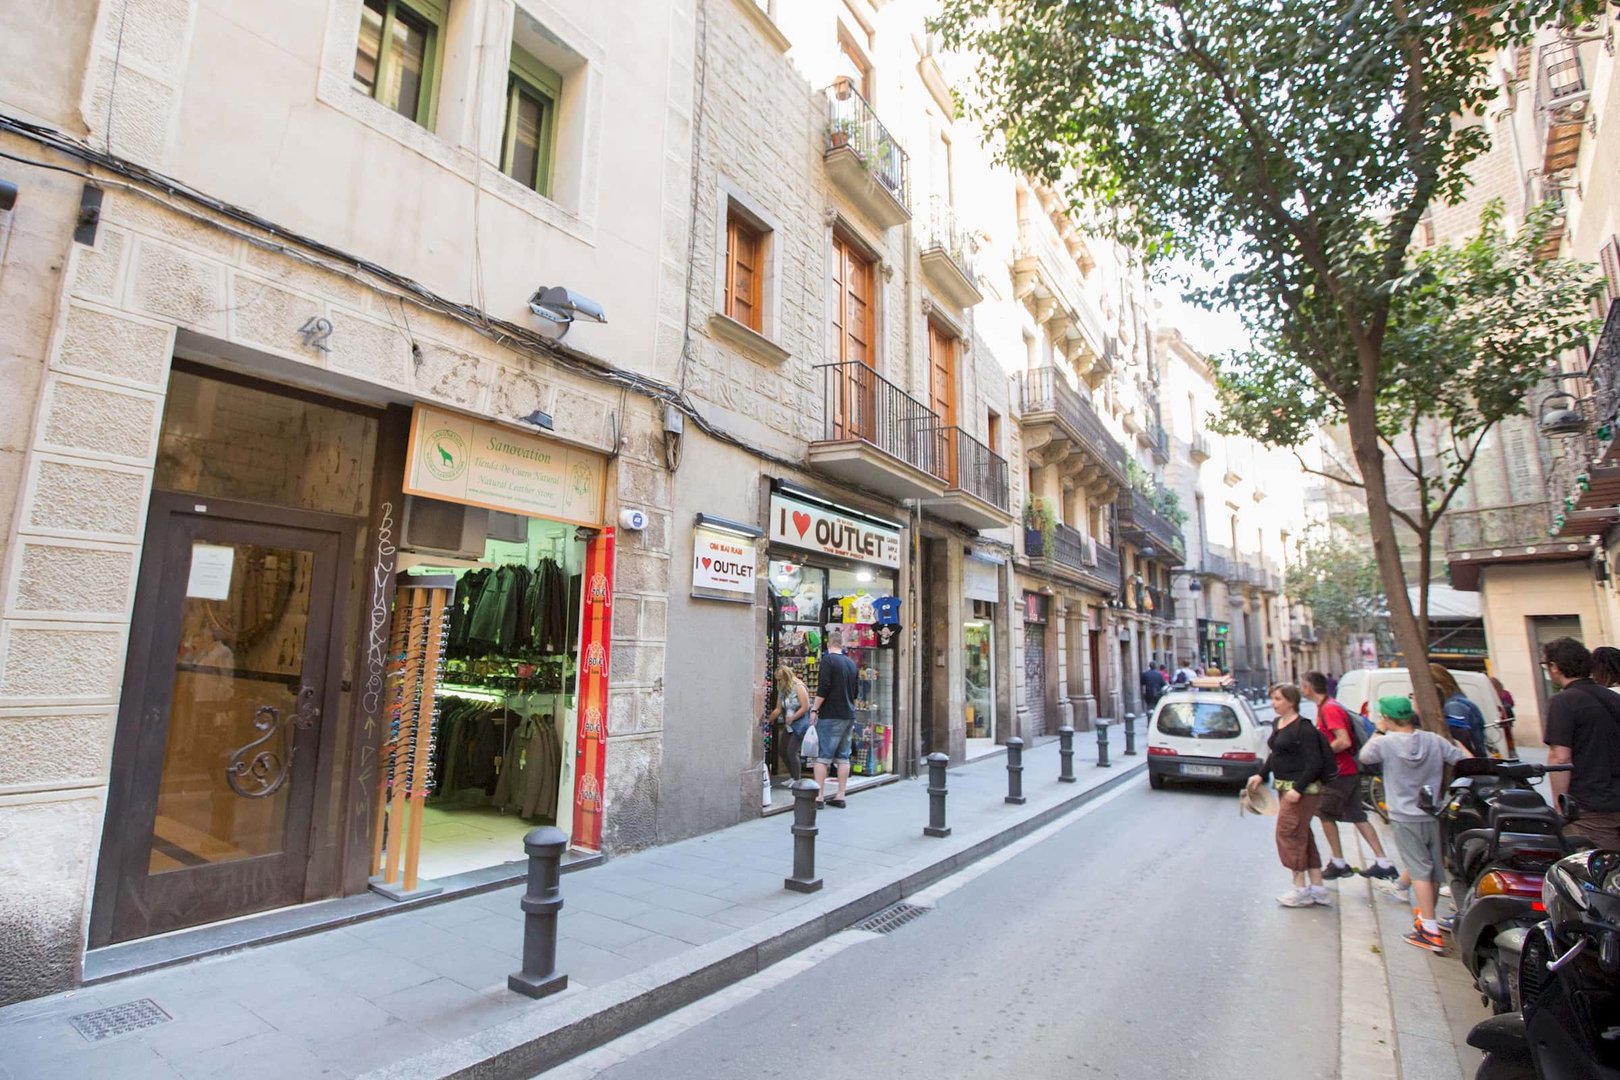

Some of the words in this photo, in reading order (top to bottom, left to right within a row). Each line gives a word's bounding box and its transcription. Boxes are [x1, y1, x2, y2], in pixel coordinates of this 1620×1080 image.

[297, 316, 333, 352] 42
[486, 436, 551, 464] Sanovation
[474, 457, 498, 470] Tienda
[533, 471, 561, 485] Natural
[480, 475, 507, 488] Natural
[508, 482, 534, 494] Leather
[535, 488, 554, 499] Store
[780, 507, 786, 536] I
[816, 518, 885, 558] OUTLET
[695, 556, 699, 569] I
[713, 560, 753, 577] OUTLET
